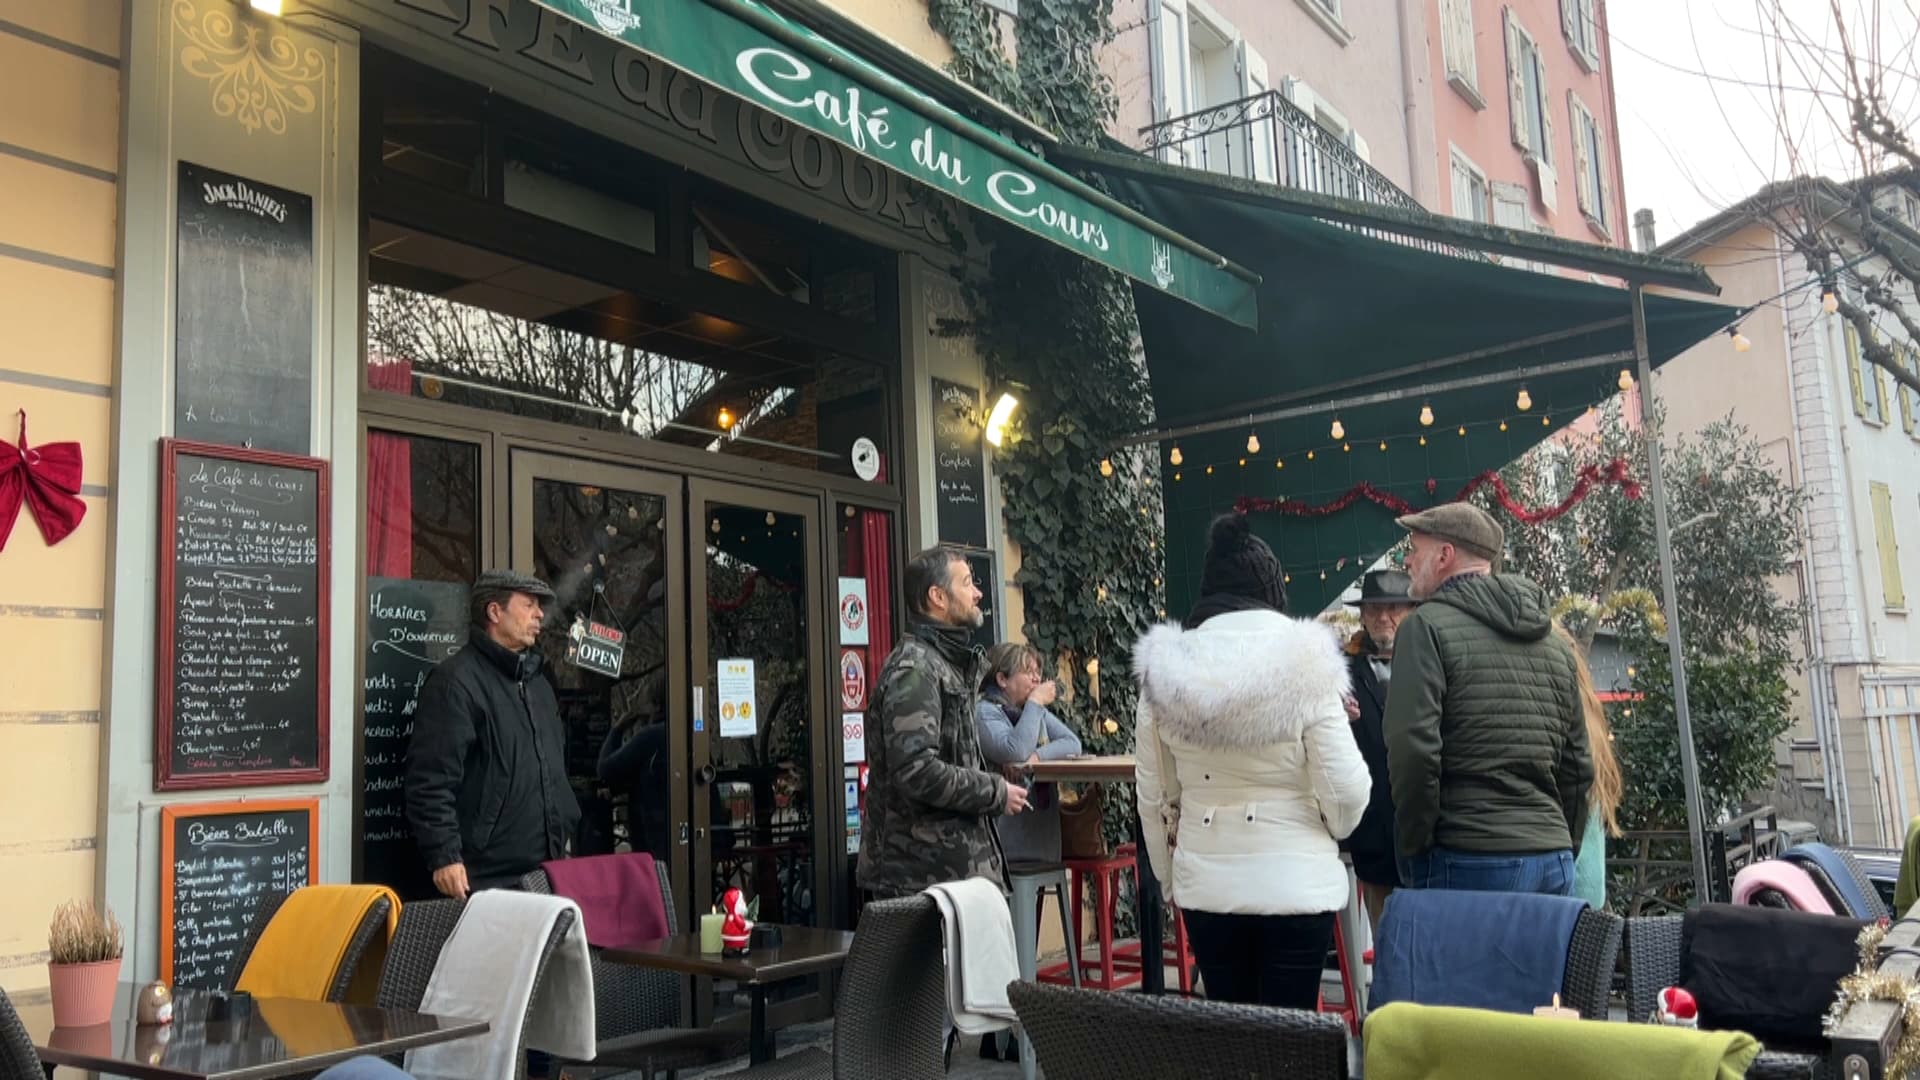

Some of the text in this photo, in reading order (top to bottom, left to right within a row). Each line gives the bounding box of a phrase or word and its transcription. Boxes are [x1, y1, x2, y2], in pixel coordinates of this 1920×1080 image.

[735, 47, 1109, 252] Café du Cours
[203, 182, 238, 204] JACK
[580, 643, 619, 670] OPEN
